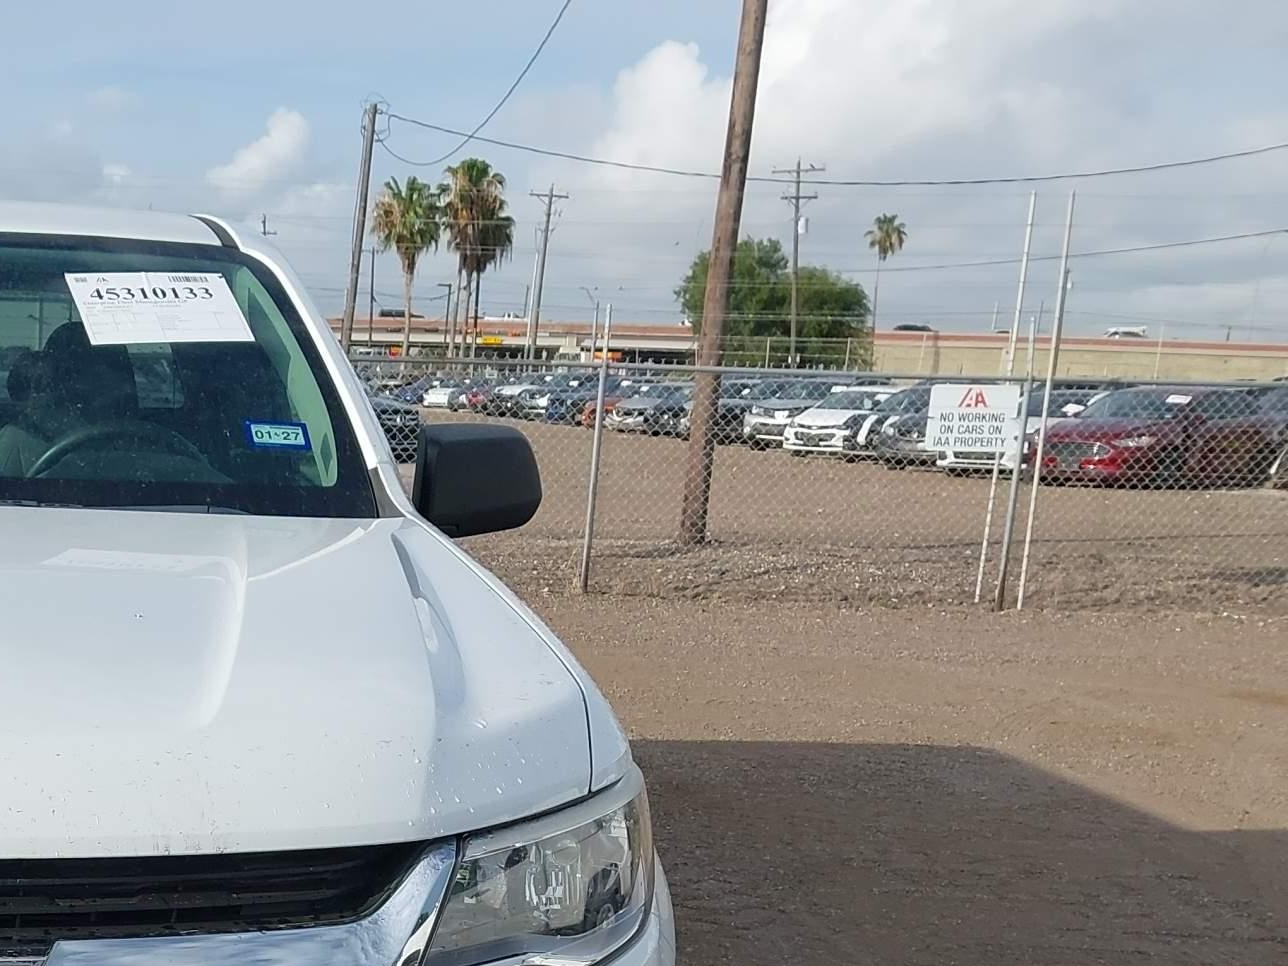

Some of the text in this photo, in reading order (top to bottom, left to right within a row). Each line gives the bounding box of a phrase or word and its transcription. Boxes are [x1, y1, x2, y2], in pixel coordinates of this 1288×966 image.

[89, 287, 214, 301] 45310133
[939, 412, 1005, 423] NO WORKING
[254, 430, 300, 441] 01 27
[939, 425, 1002, 435] ON CARS ON
[933, 437, 1006, 448] IAA PROPERTY
